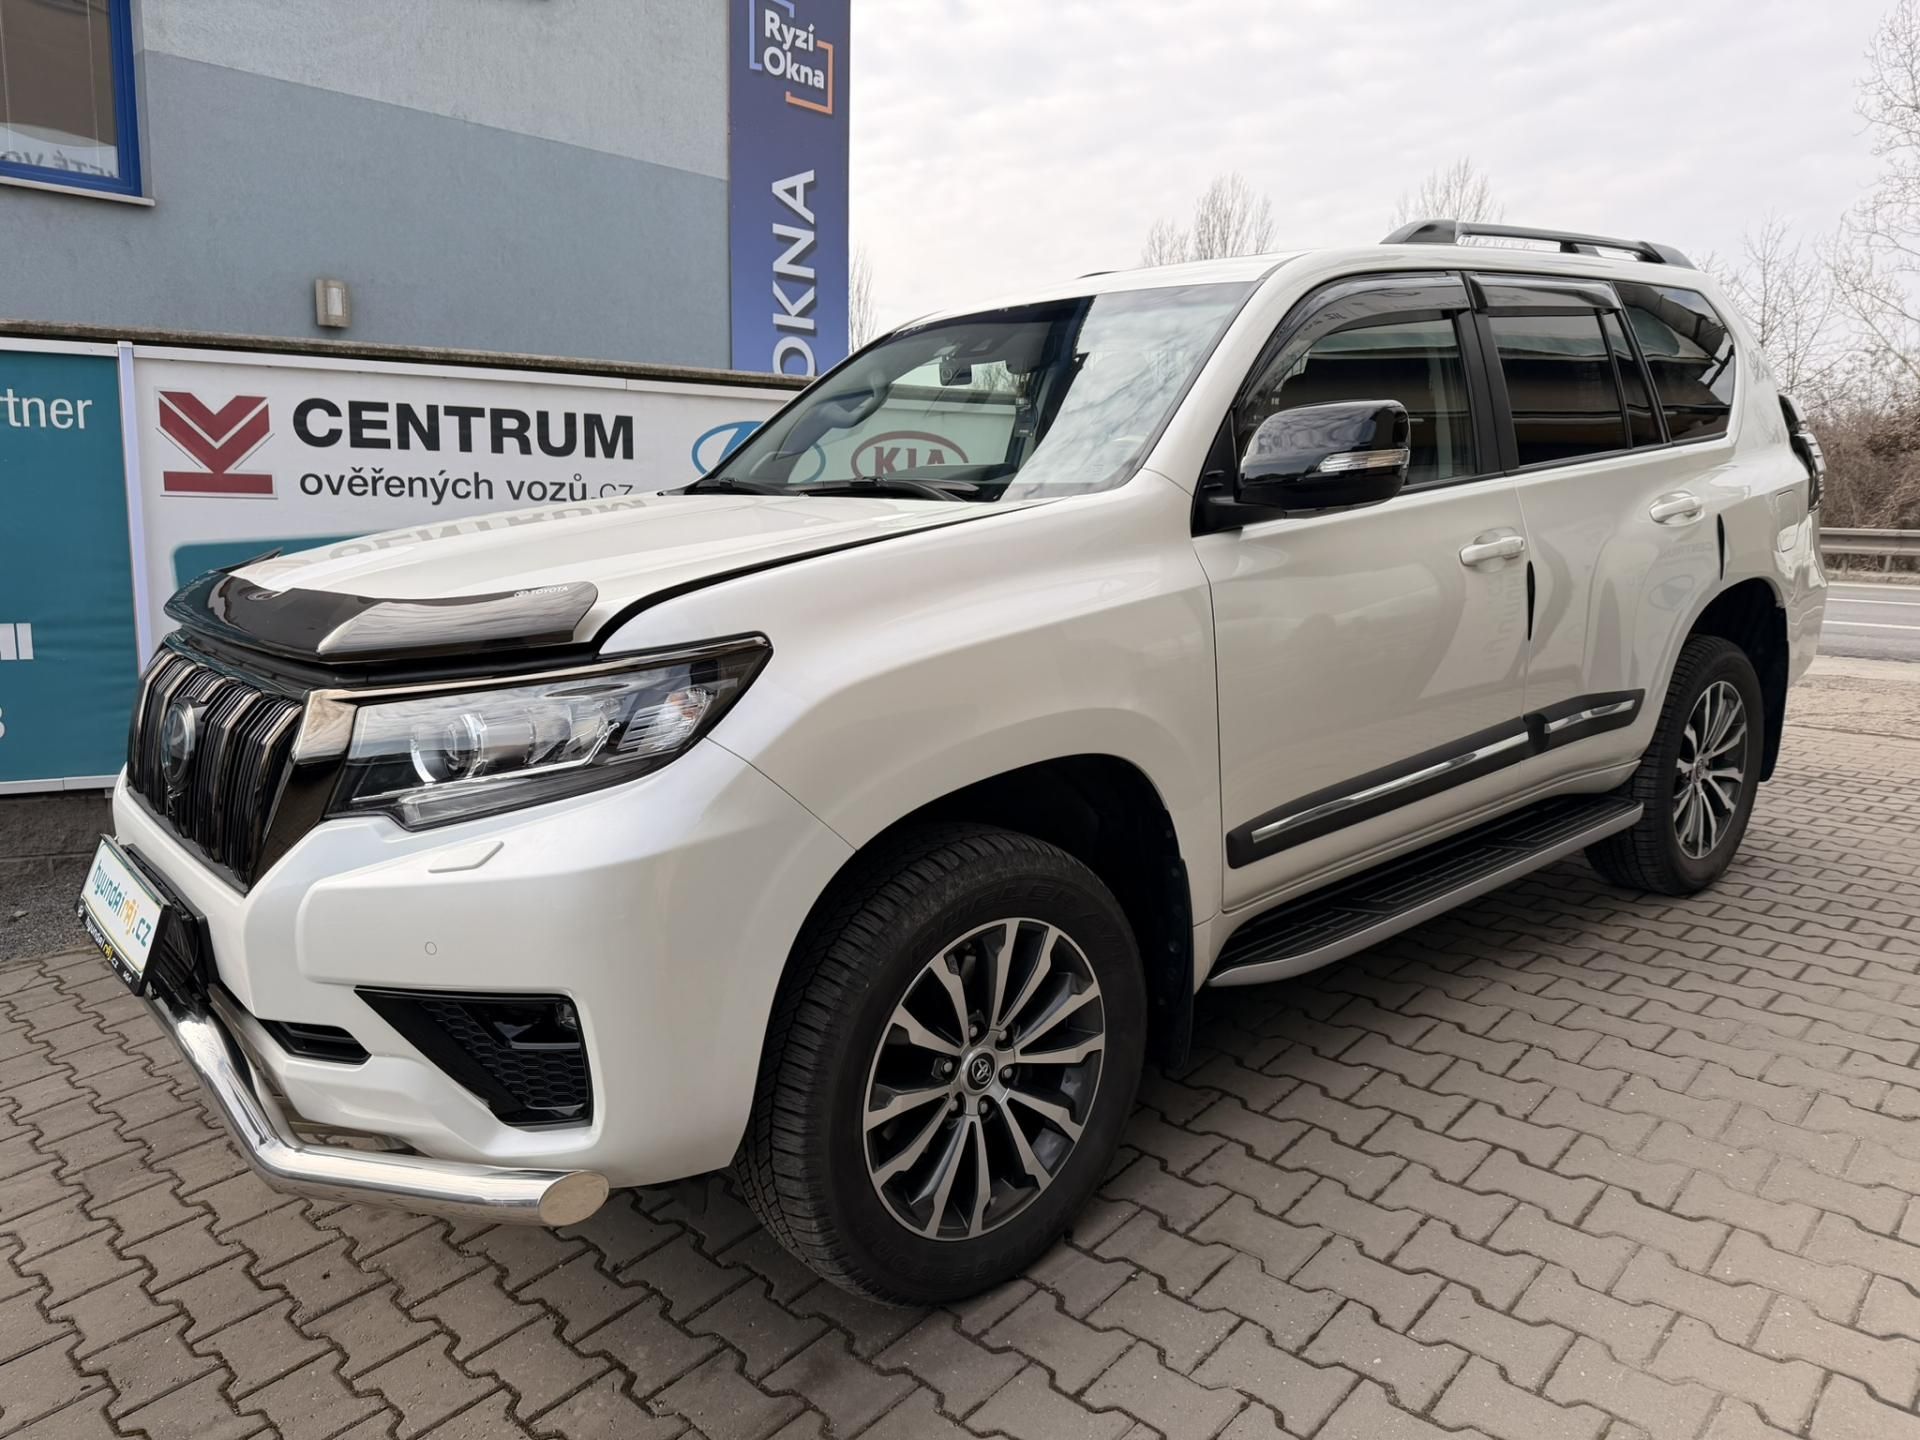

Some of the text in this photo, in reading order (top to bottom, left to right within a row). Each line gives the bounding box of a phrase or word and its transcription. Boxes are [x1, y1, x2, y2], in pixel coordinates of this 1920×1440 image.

[763, 46, 825, 90] Okna
[771, 169, 816, 376] OKNA
[0, 388, 93, 430] tner
[292, 397, 634, 460] CENTRUM
[299, 467, 494, 506] ověřených
